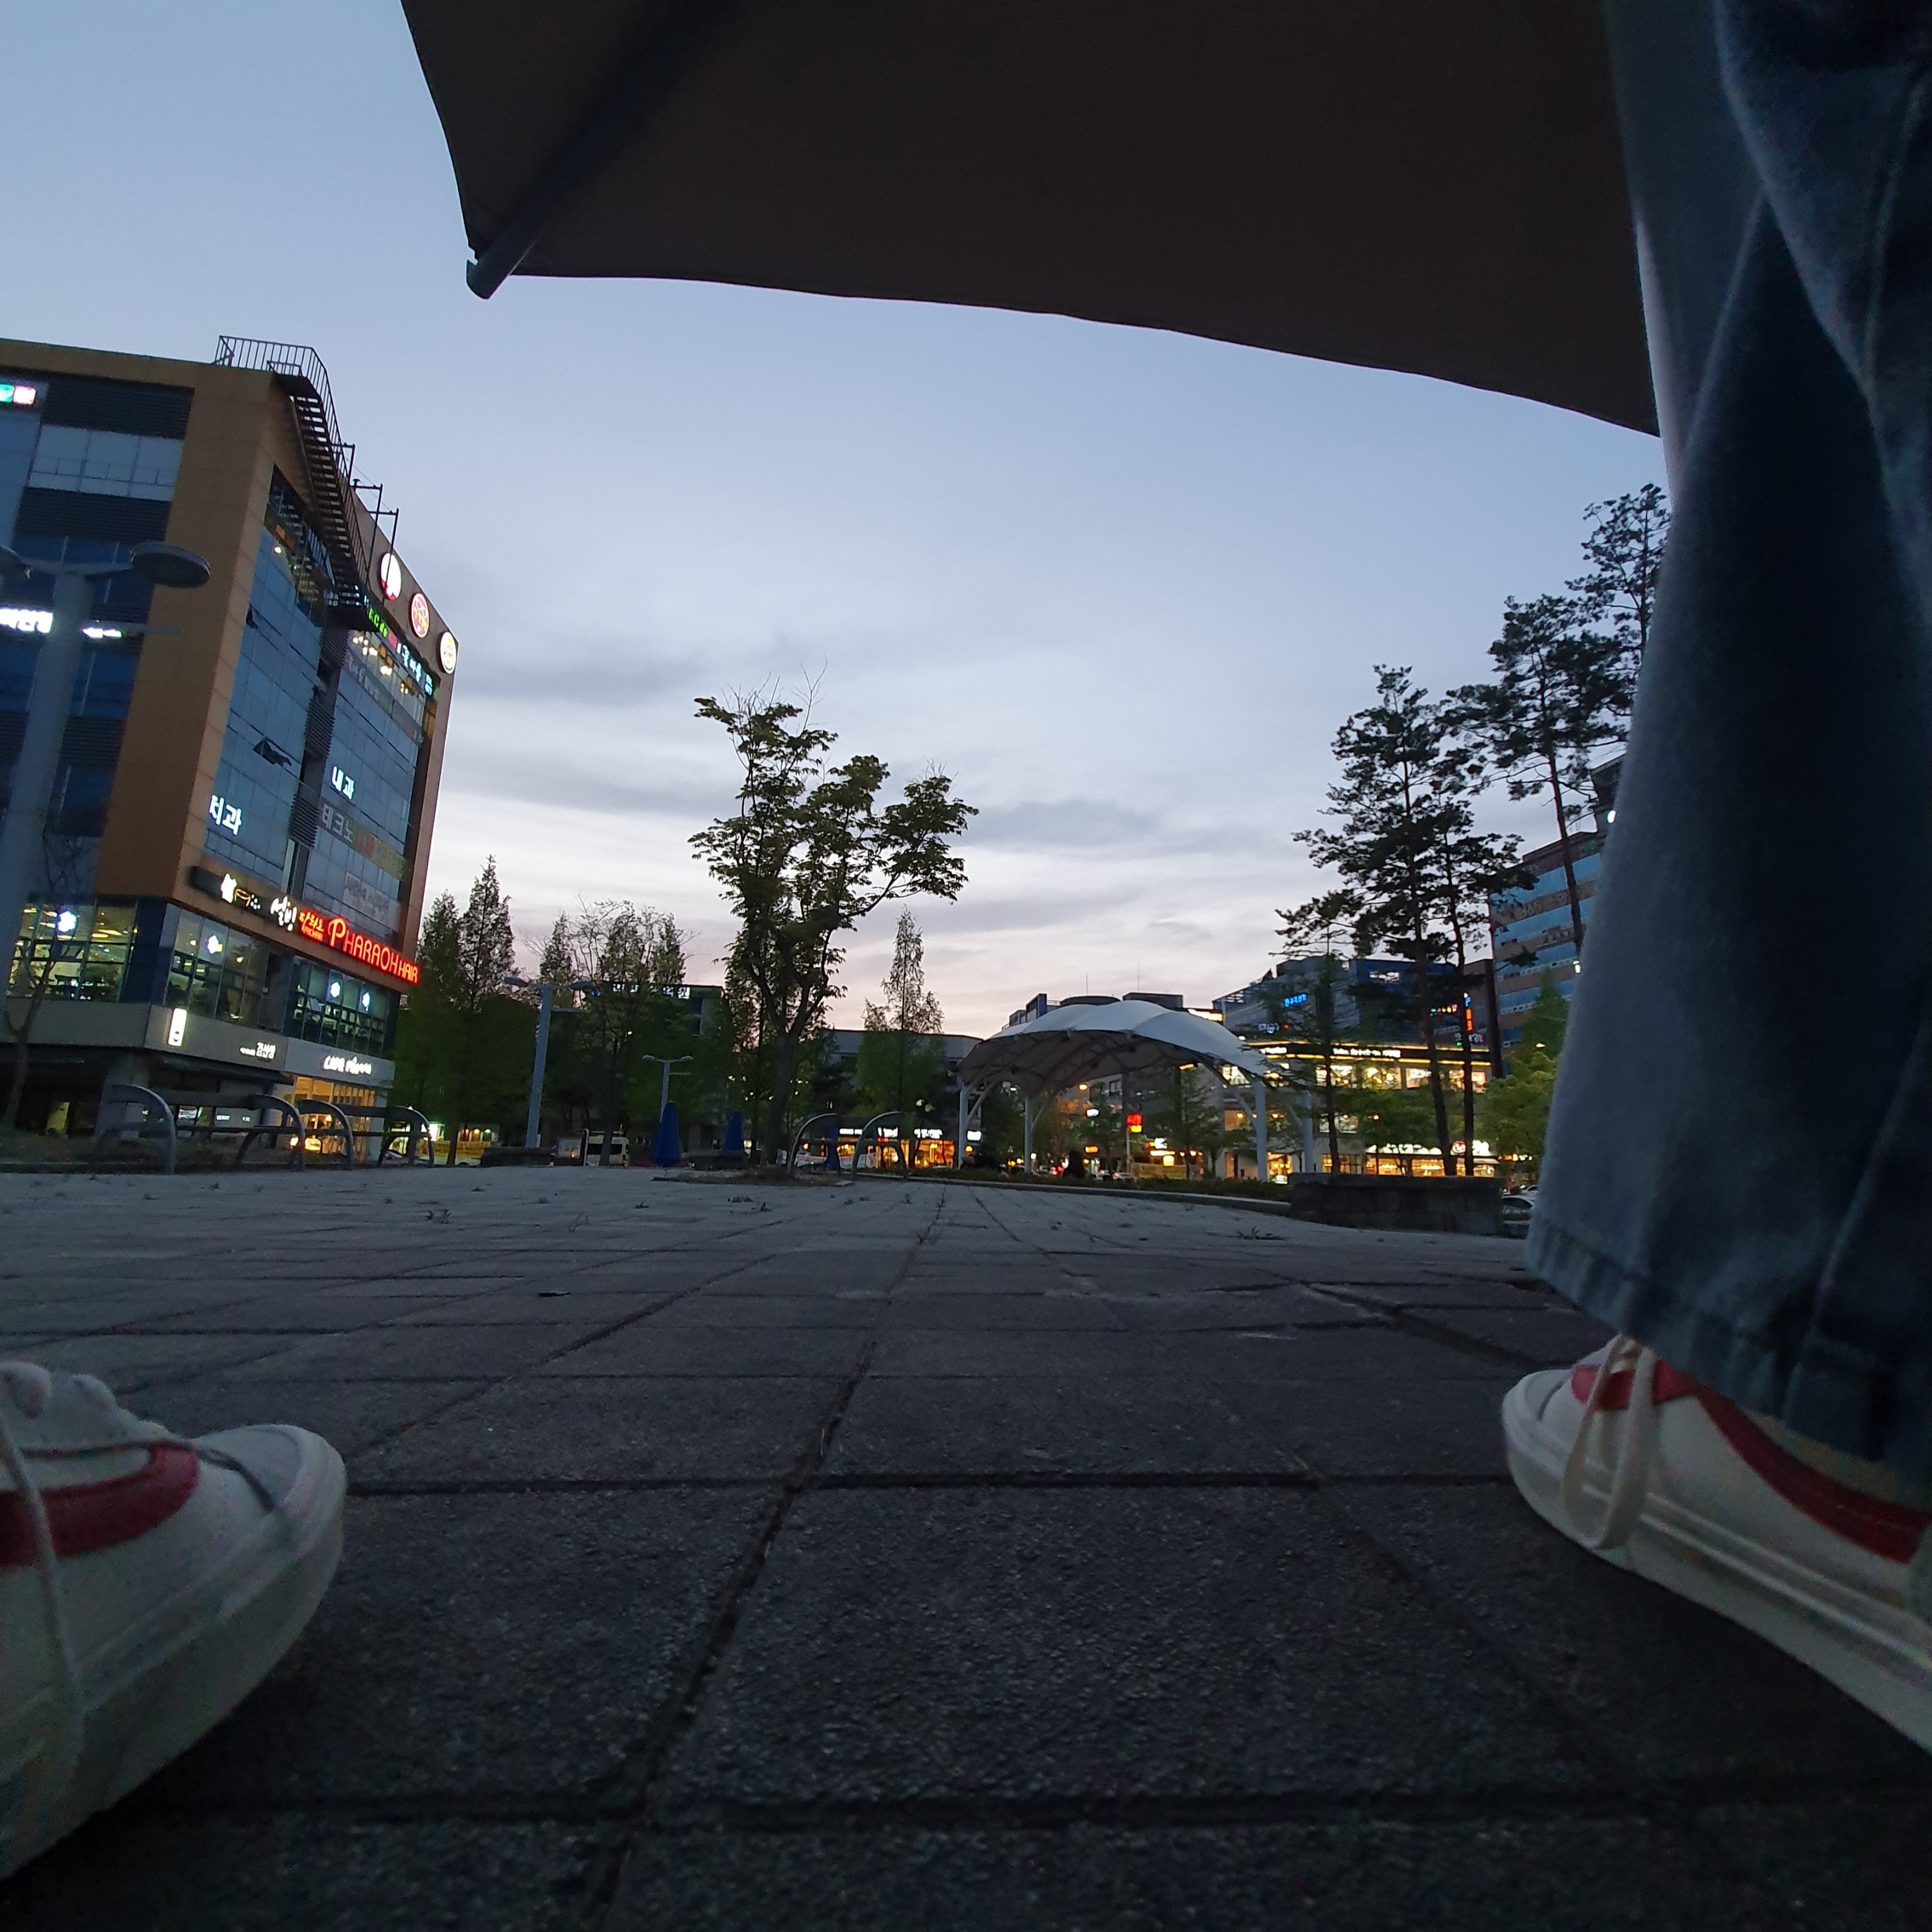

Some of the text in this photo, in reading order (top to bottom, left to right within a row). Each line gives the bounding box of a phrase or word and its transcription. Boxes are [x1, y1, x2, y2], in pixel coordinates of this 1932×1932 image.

[332, 766, 355, 800] 내과
[209, 795, 242, 835] 치과
[322, 803, 354, 843] 테크노
[270, 895, 297, 931] 설빙
[328, 917, 419, 984] PHARAOH HAIR
